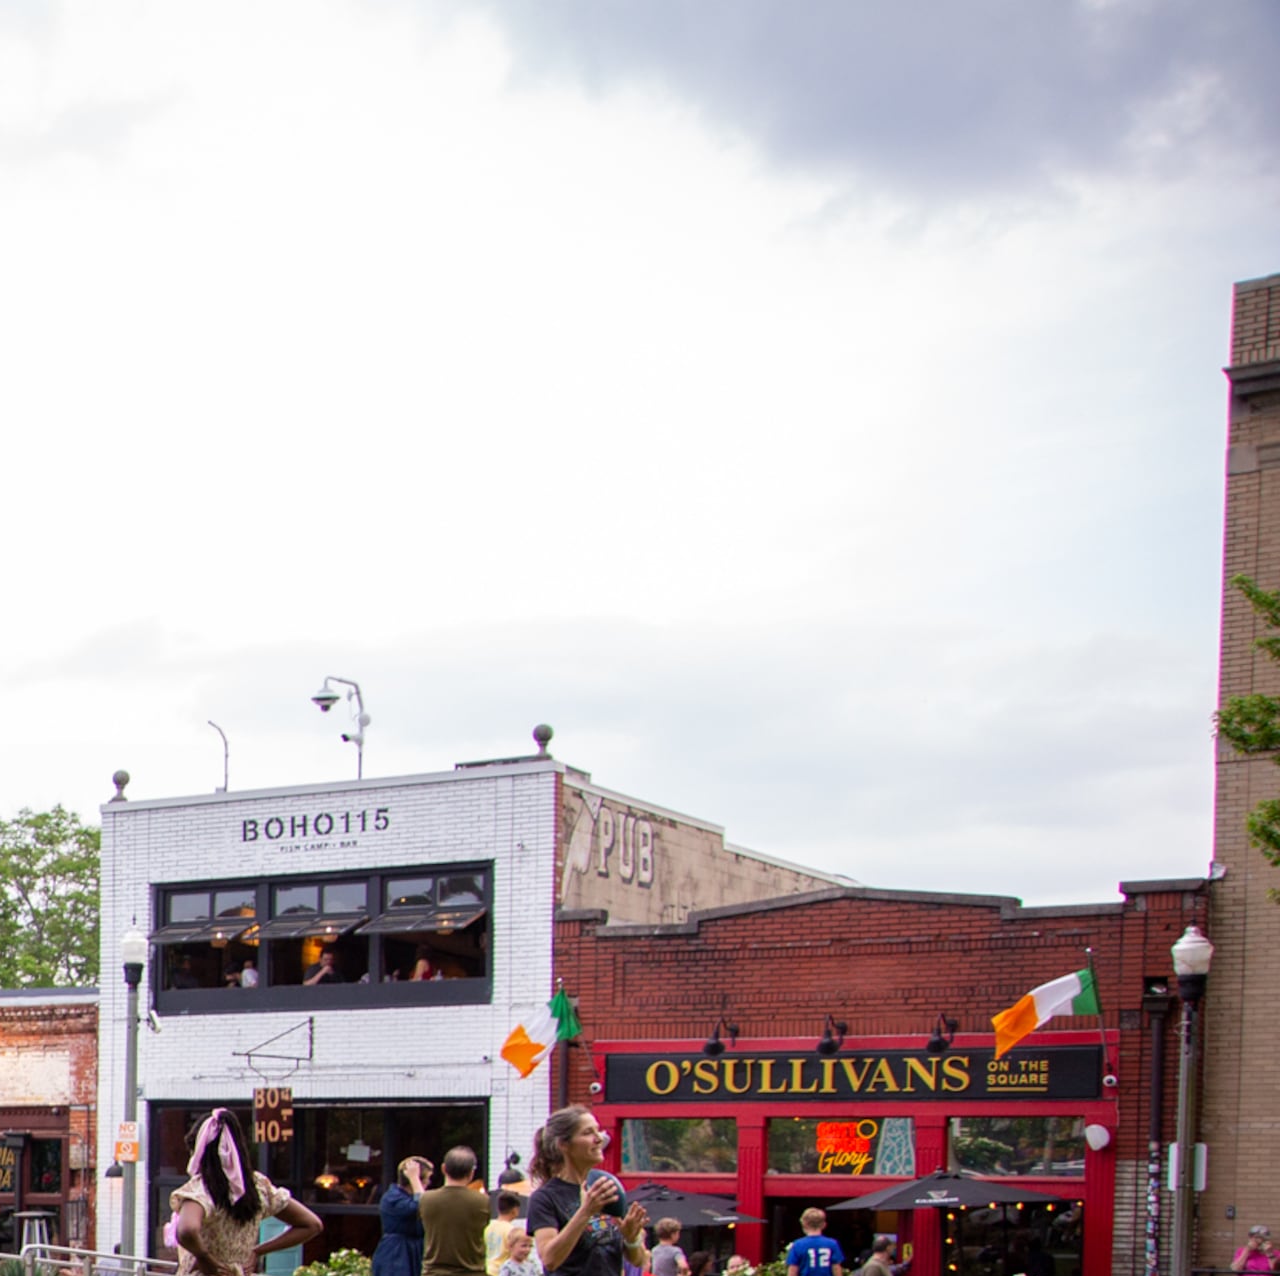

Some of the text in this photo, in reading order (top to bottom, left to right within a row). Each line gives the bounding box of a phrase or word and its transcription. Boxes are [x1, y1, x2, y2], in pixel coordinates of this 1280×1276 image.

[242, 807, 389, 842] BOHO115
[597, 804, 654, 890] PUB
[645, 1056, 970, 1094] O'SULLIVANS
[986, 1073, 1049, 1085] SQUARE
[987, 1059, 1049, 1072] ON THE
[818, 1145, 873, 1176] Glory
[807, 1247, 832, 1268] 12
